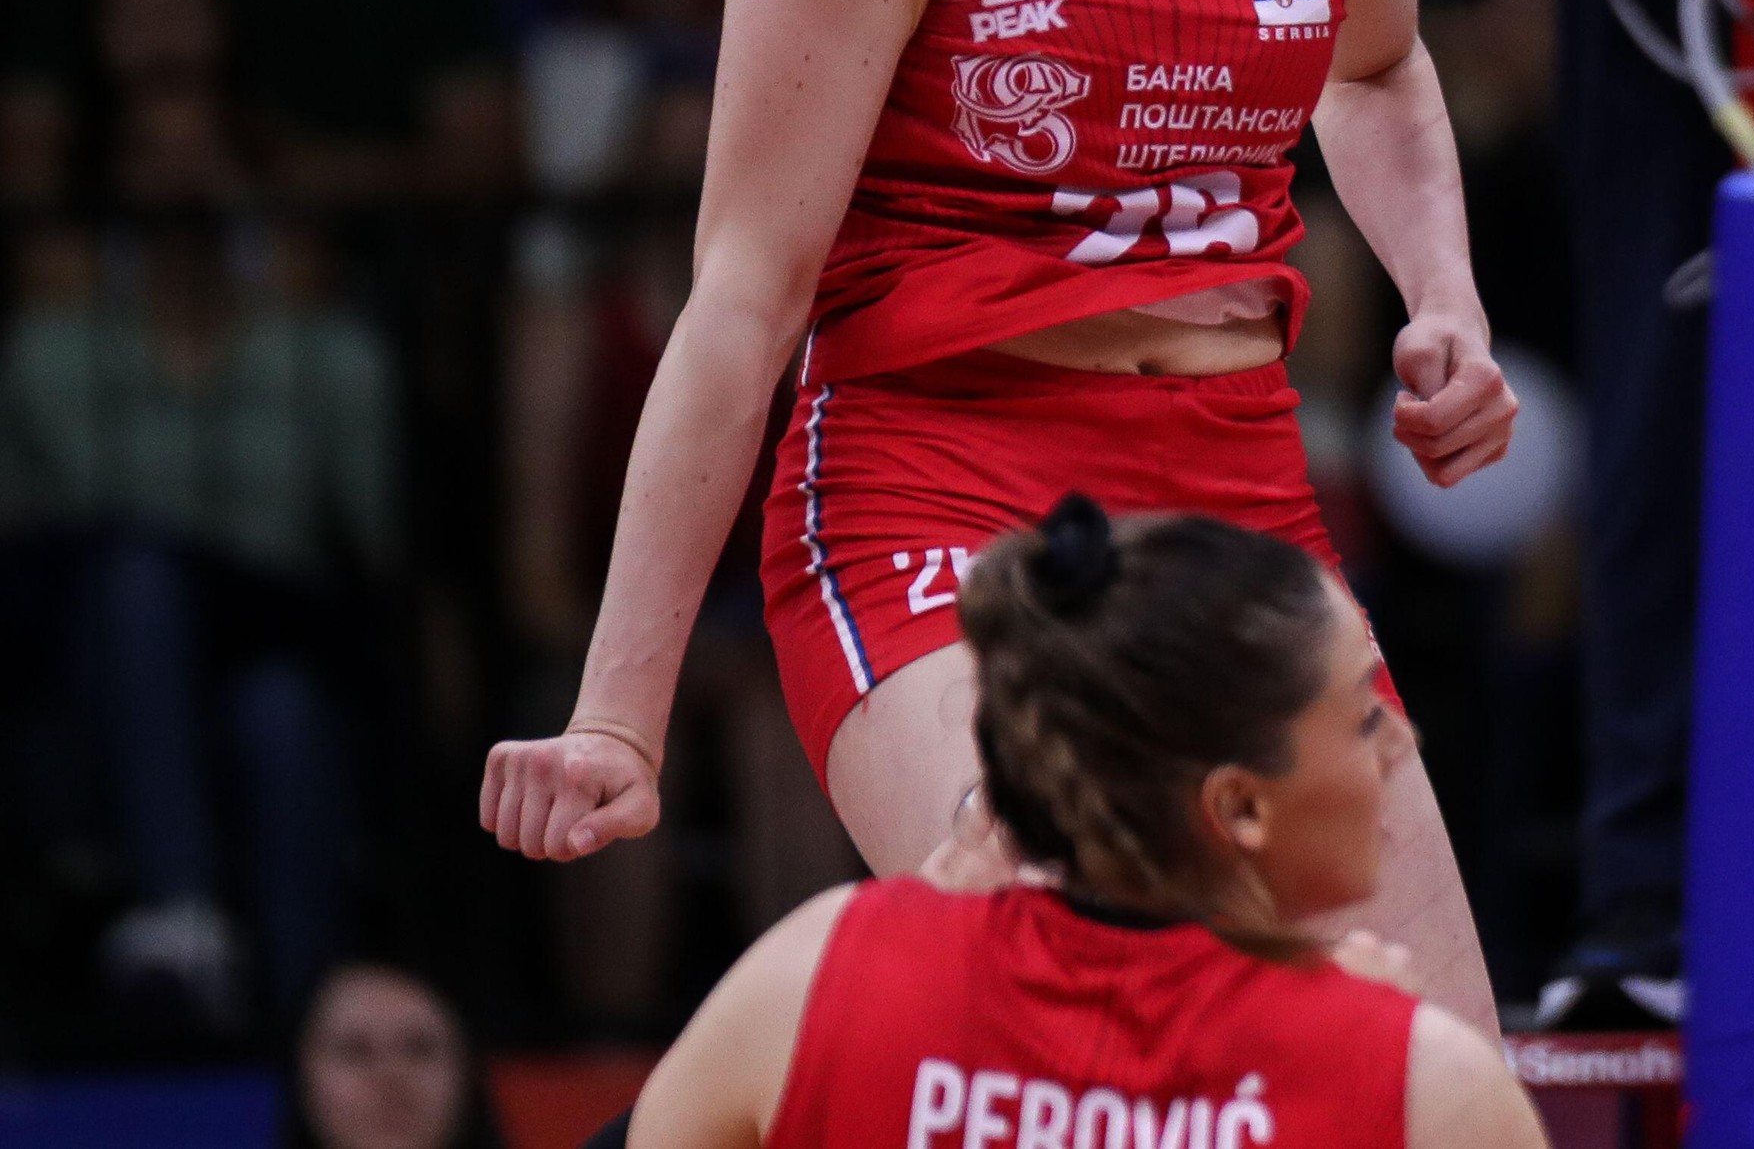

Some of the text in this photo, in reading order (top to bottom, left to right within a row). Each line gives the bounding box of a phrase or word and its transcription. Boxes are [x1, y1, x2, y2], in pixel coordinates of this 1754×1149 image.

[1258, 26, 1330, 41] SERBIA
[1126, 64, 1233, 92] БАНКА
[1119, 103, 1303, 133] ПОШТАНСКА
[892, 546, 968, 616] 2
[906, 1057, 1274, 1149] PEROVIĆ
